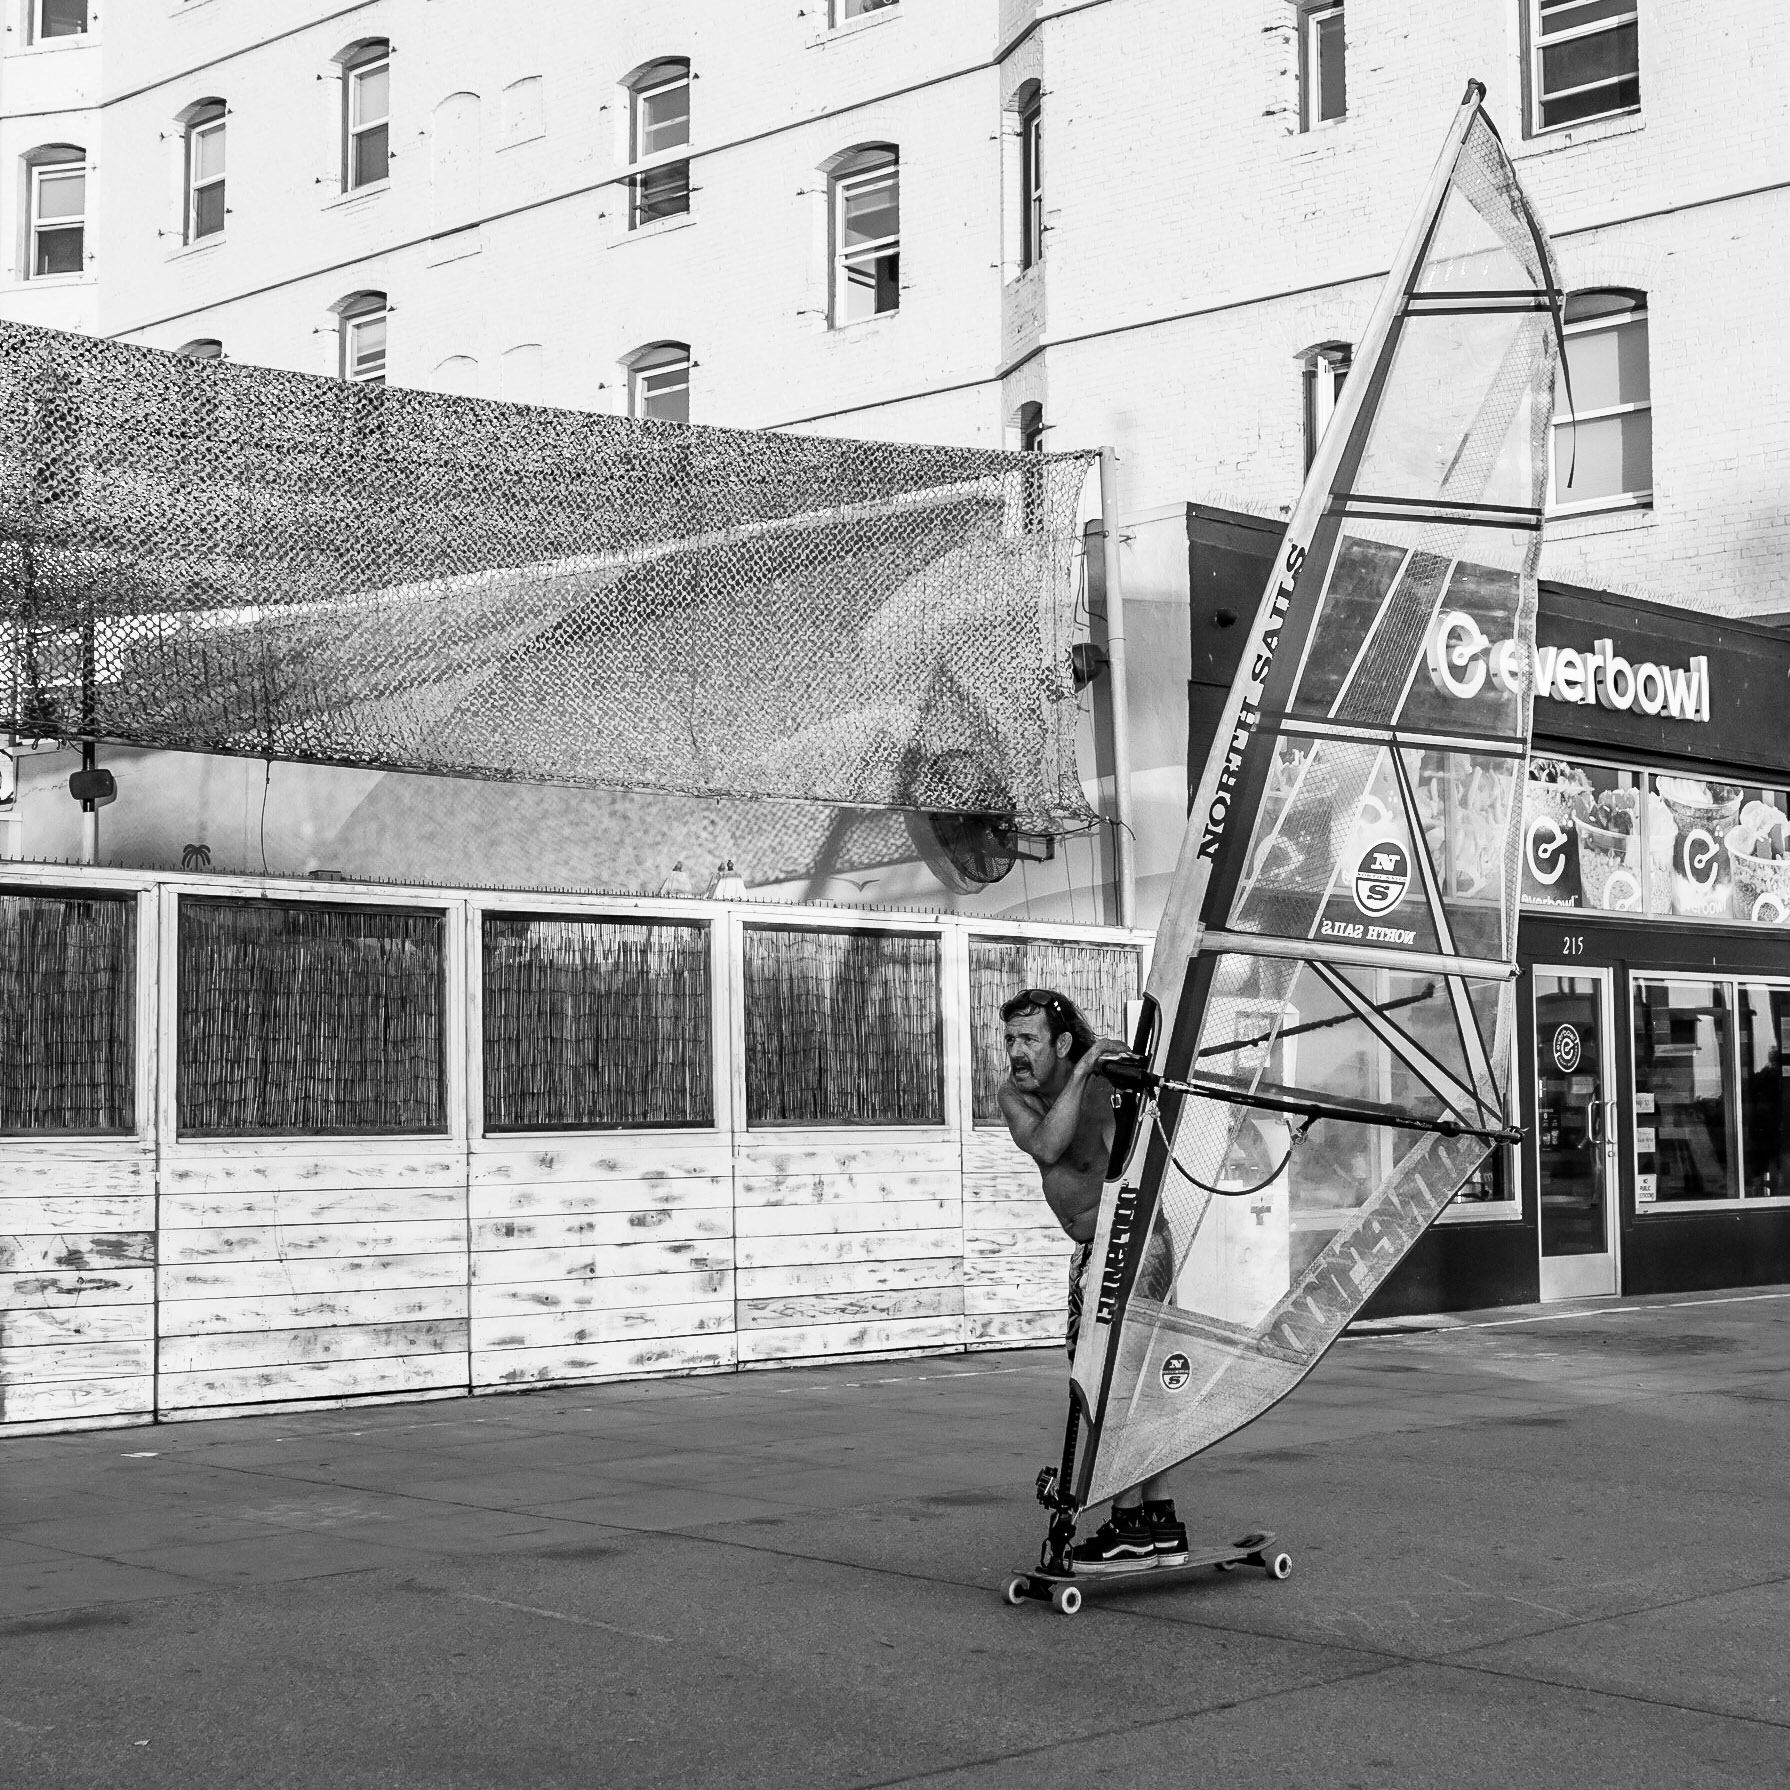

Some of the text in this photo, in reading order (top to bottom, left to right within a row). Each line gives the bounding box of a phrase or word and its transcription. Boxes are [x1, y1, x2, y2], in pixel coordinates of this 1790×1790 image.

[1197, 544, 1306, 859] NORTH SAILS
[1489, 638, 1709, 722] everbowl
[1562, 936, 1584, 955] 215
